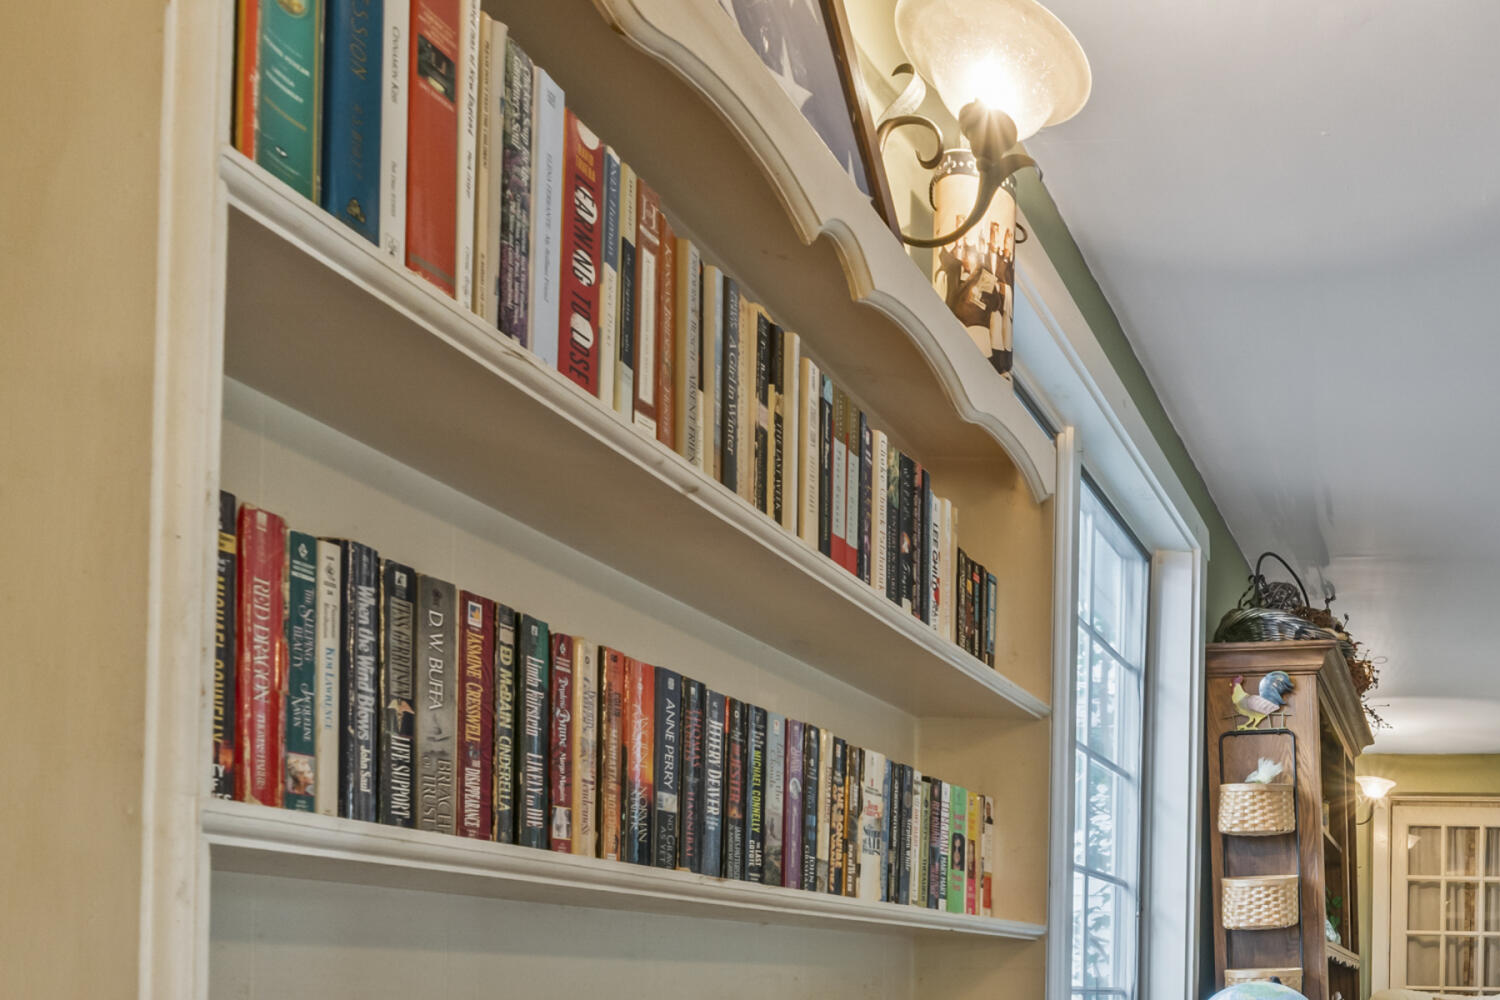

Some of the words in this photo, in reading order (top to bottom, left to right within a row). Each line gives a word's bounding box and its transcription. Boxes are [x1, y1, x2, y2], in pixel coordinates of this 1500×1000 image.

[469, 67, 477, 90] New
[512, 56, 521, 118] Gardener's
[522, 67, 531, 114] Chicken
[511, 124, 521, 150] Soul
[522, 118, 530, 146] Soup
[521, 167, 530, 187] the
[522, 149, 530, 164] for
[572, 173, 595, 287] LEARNING
[572, 291, 592, 322] TO
[569, 327, 591, 385] LOSE
[730, 335, 737, 350] A
[728, 353, 737, 384] Girl
[689, 374, 697, 421] ABSENT
[729, 385, 737, 400] in
[727, 402, 736, 457] Winter
[253, 576, 270, 621] RED
[358, 585, 375, 626] When
[429, 610, 444, 629] D.
[293, 626, 303, 670] BEAUTY
[300, 605, 314, 662] SLEEPING
[358, 627, 375, 652] the
[428, 633, 444, 653] W.
[466, 630, 484, 680] JASMINE
[500, 645, 513, 666] ED
[253, 623, 270, 705] DRAGON
[325, 648, 336, 670] KIM
[358, 655, 374, 692] Wind
[527, 655, 545, 688] Linda
[325, 672, 335, 730] LAWRENCE
[428, 656, 444, 711] BUFFA
[500, 668, 513, 730] McBAIN
[301, 683, 315, 741] JACQUELINE
[357, 695, 375, 741] Blows
[465, 682, 483, 743] CRESSWELL
[526, 688, 544, 738] Fairstein
[665, 698, 676, 742] ANNE
[360, 746, 371, 772] John
[391, 734, 410, 762] LIFE
[664, 744, 675, 789] PERRY
[708, 720, 723, 768] JEFFERY
[360, 772, 371, 793] Saul
[499, 735, 512, 812] CINDERELLA
[526, 752, 543, 796] LIKELY
[730, 754, 742, 803] JESTER
[752, 750, 761, 787] MICHAEL
[391, 764, 410, 819] SUPPORT
[423, 774, 437, 826] TRUST
[437, 760, 452, 829] BREACH
[464, 767, 481, 829] DISAPPEARANCE
[706, 769, 721, 816] DEAVER
[752, 790, 760, 833] CONNELLY
[526, 808, 543, 829] DIE
[686, 792, 695, 857] HANNIBAL
